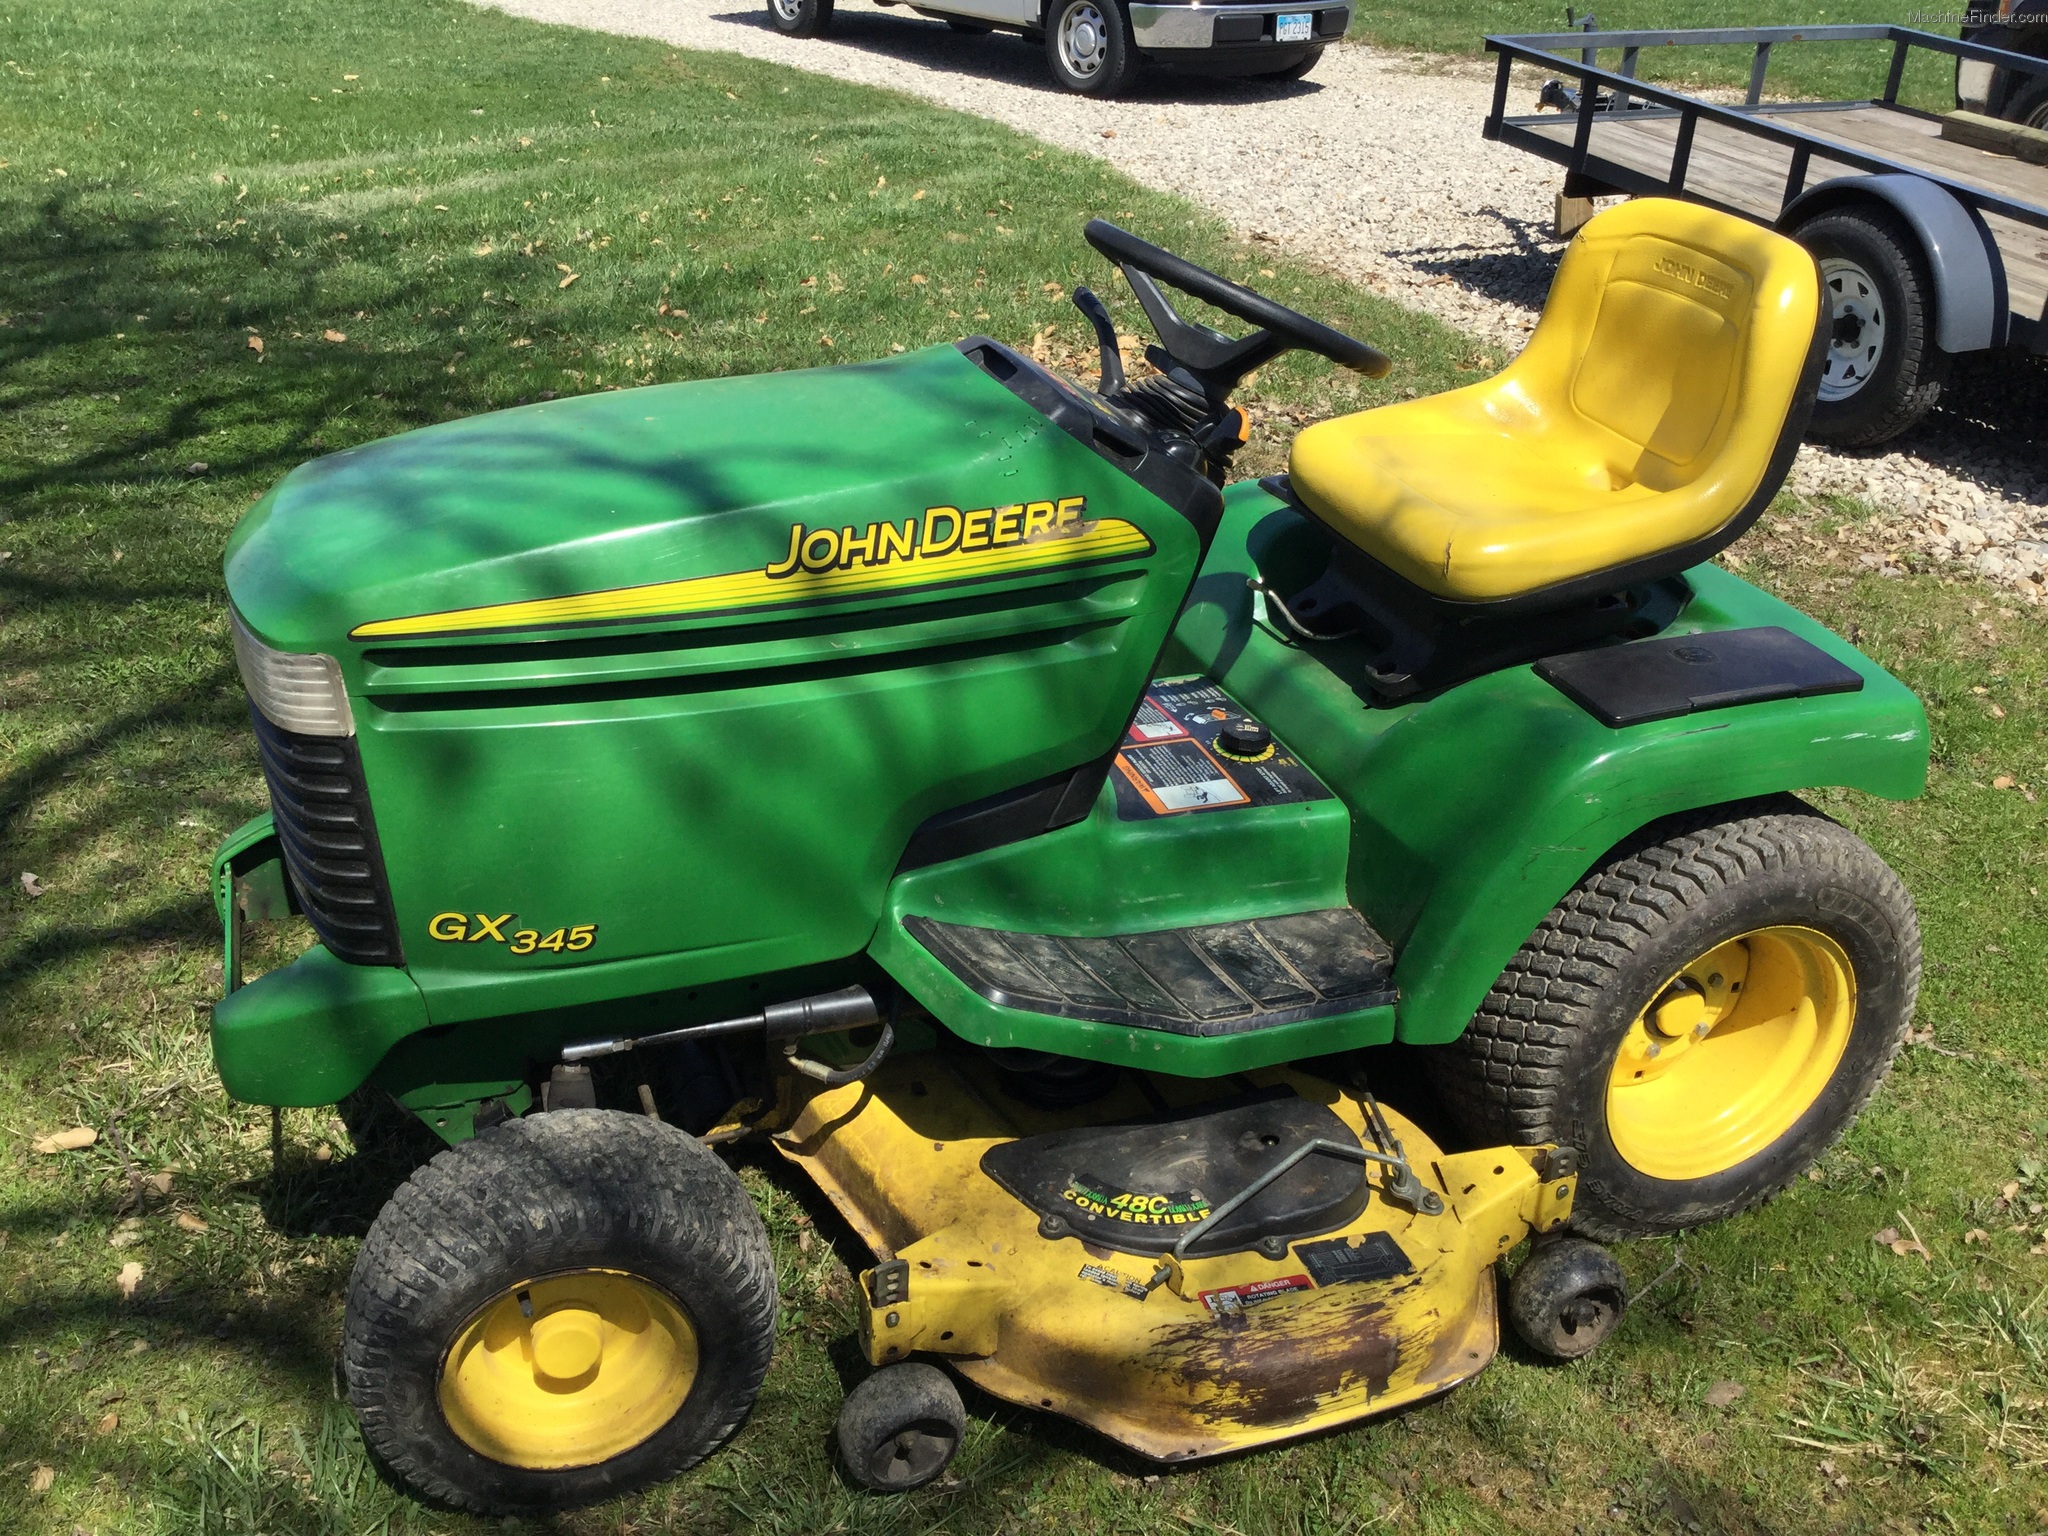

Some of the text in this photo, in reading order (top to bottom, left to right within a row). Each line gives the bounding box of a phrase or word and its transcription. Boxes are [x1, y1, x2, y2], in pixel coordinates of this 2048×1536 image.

[765, 496, 1088, 578] JOHN DEERE
[428, 912, 598, 956] GX 345
[1062, 1189, 1211, 1225] CONVERTIBLE
[1111, 1193, 1169, 1215] 48C
[1246, 1290, 1278, 1300] ROTATING
[1257, 1279, 1291, 1291] DANGER
